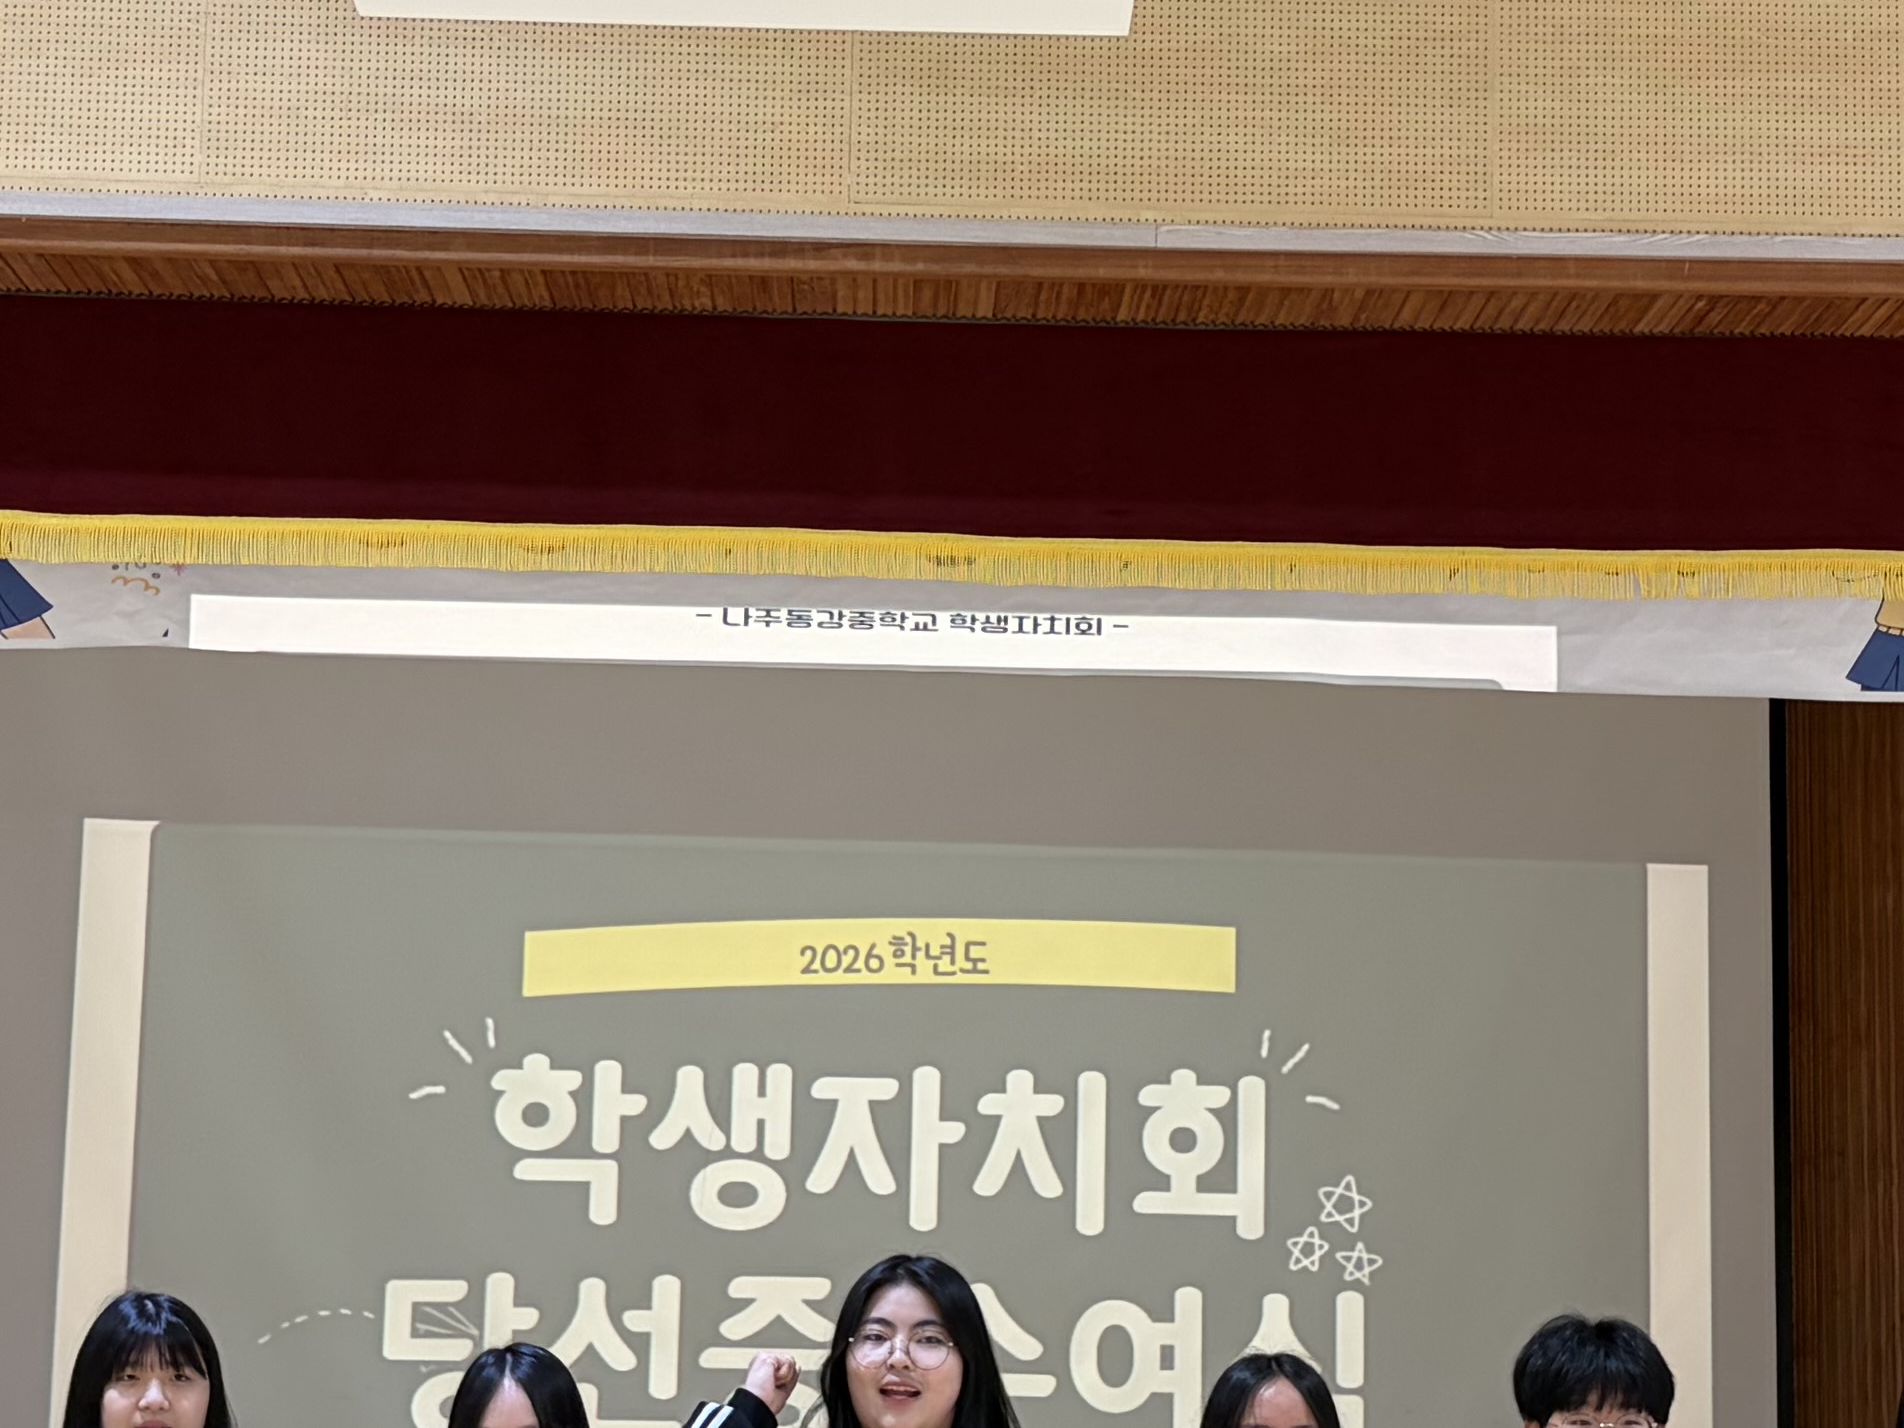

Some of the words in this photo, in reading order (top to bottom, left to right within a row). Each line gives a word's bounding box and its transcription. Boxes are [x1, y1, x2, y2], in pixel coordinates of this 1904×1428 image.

[721, 606, 939, 633] 나주동강중학교
[949, 611, 1102, 636] 학생자치회
[800, 931, 990, 976] 2026학년도
[492, 1053, 1266, 1240] 학생자치회
